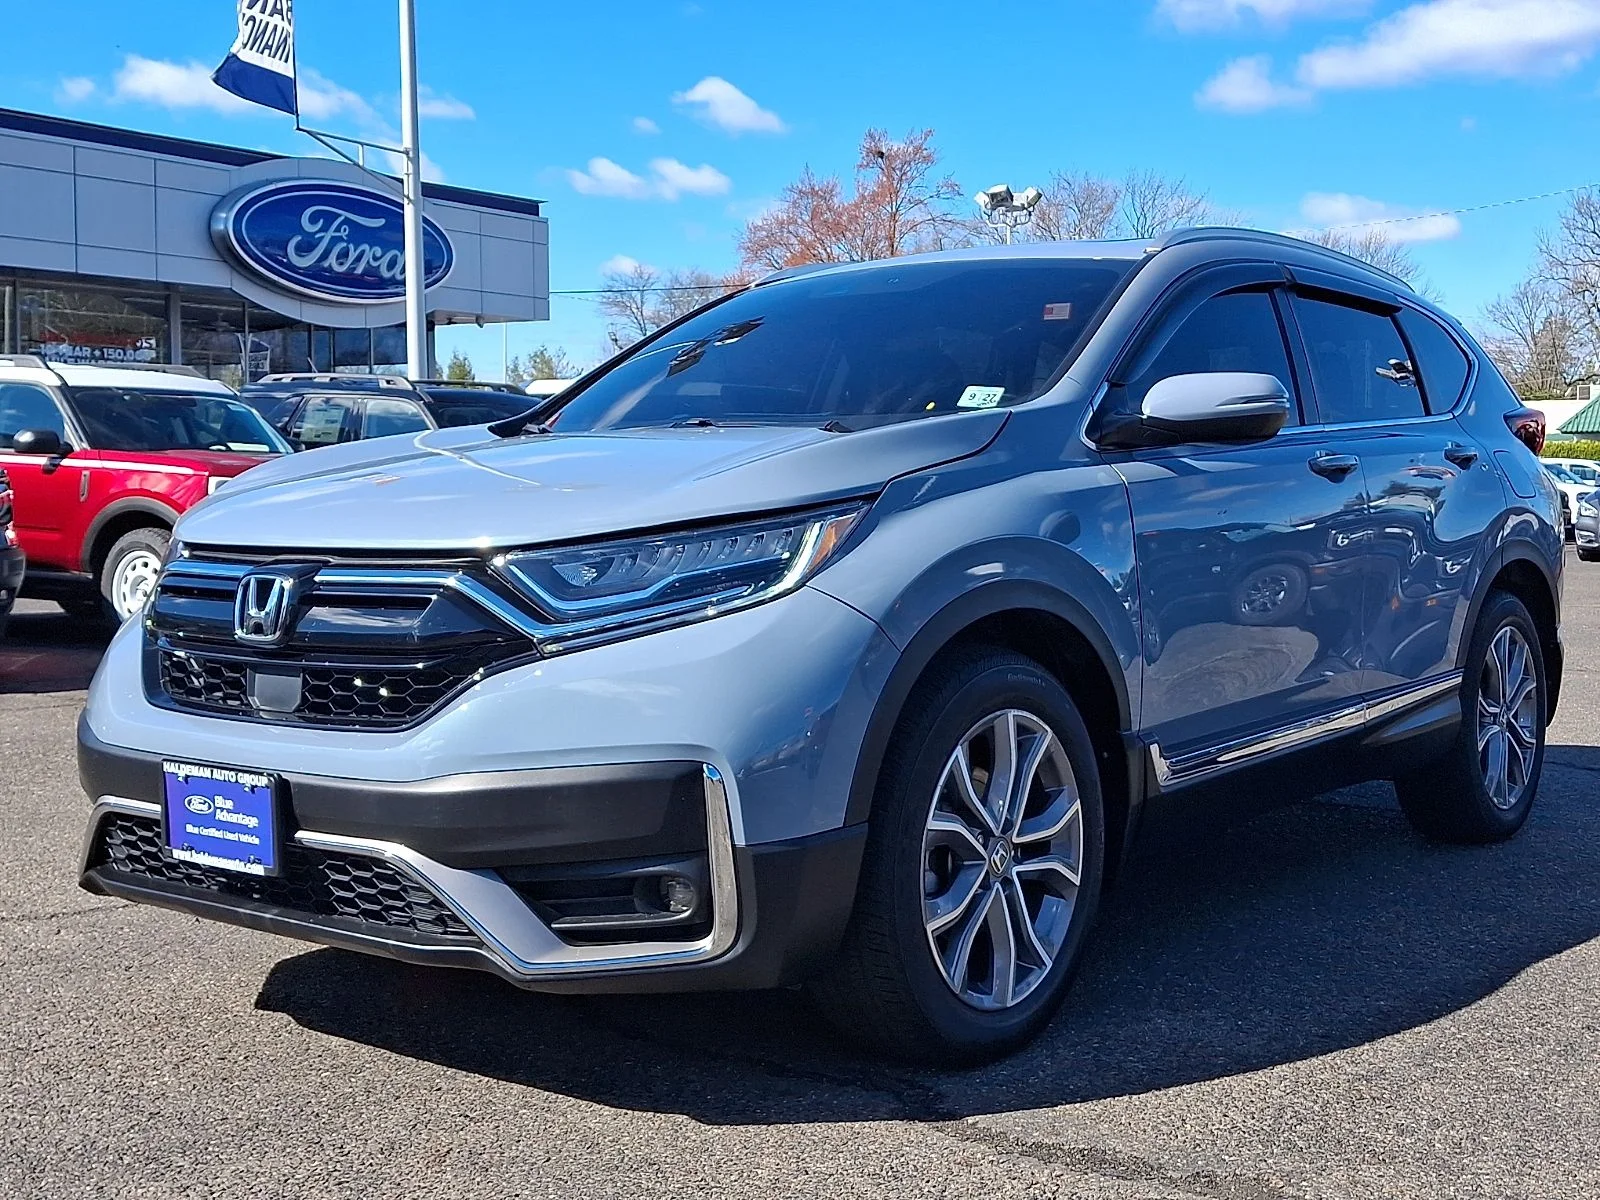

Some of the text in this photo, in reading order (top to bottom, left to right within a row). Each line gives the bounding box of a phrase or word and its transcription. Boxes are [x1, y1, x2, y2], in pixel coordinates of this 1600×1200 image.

[163, 761, 269, 788] HALDEMAN AUTO GROUP
[214, 795, 234, 810] Blue
[215, 808, 259, 829] Advantage
[185, 823, 260, 846] Blue Certified Used Vehicle
